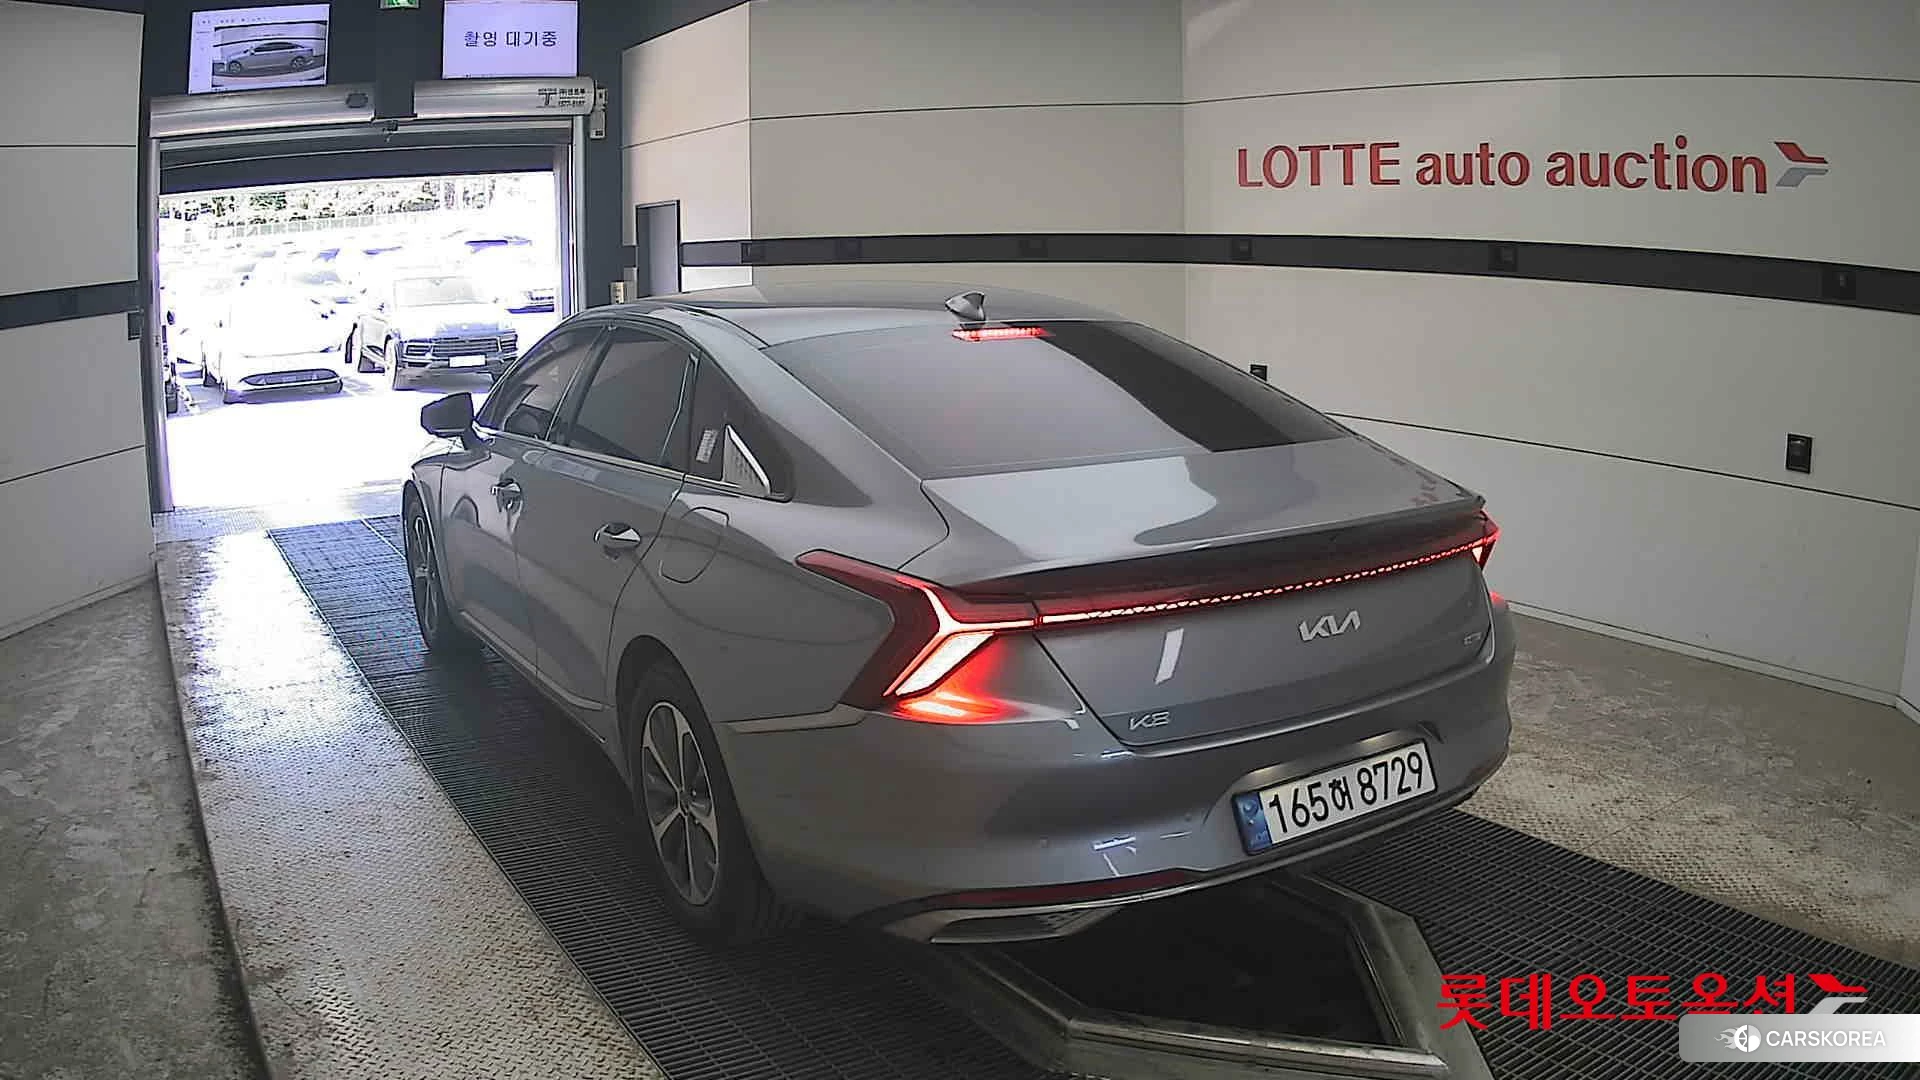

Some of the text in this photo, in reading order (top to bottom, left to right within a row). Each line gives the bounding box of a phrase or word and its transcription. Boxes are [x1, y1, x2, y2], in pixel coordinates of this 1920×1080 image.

[465, 31, 557, 47] 촬영 대기중
[1238, 135, 1768, 194] LOTTE auto auction
[1299, 610, 1360, 641] KIA
[1357, 751, 1424, 806] 8729
